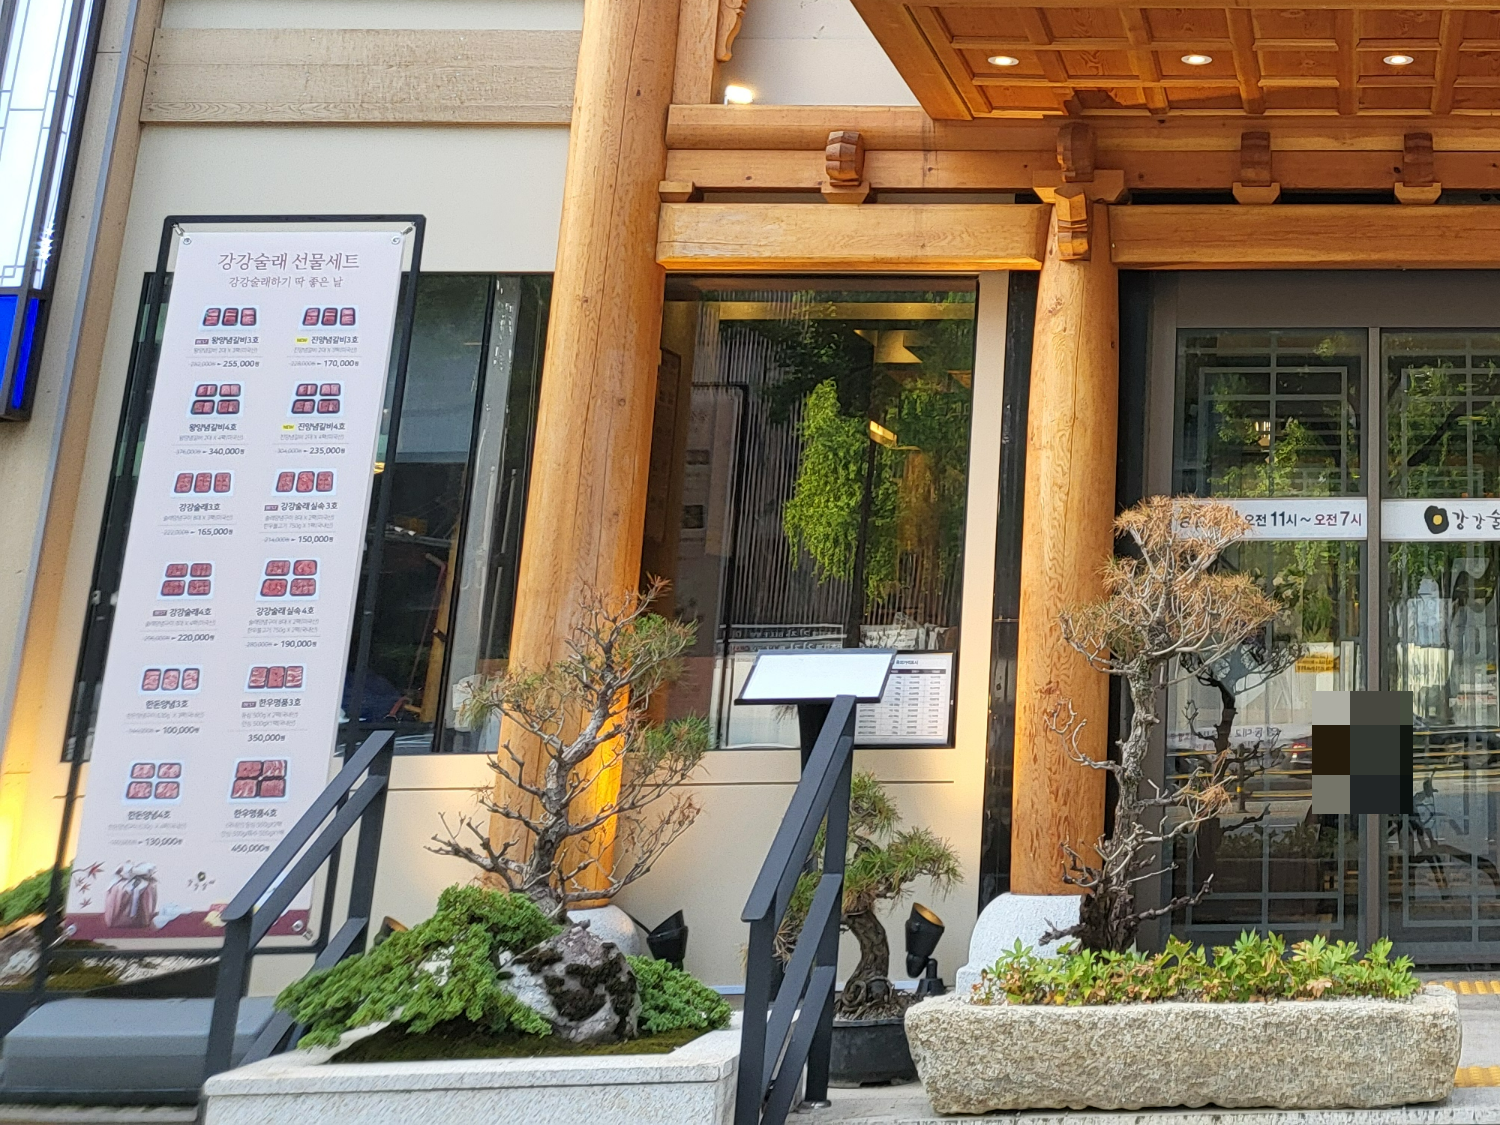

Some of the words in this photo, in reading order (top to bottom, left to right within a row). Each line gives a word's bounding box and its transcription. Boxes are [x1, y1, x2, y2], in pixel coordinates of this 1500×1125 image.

[218, 252, 287, 271] 강강술래
[291, 252, 360, 271] 선물세트
[229, 276, 291, 288] 강강술래하기
[295, 276, 305, 288] 딱
[309, 276, 329, 288] 좋은
[333, 276, 344, 288] 날
[1245, 513, 1267, 527] 오전
[1271, 511, 1297, 527] 11시
[1314, 513, 1338, 527] 오전
[1340, 511, 1362, 527] 7시
